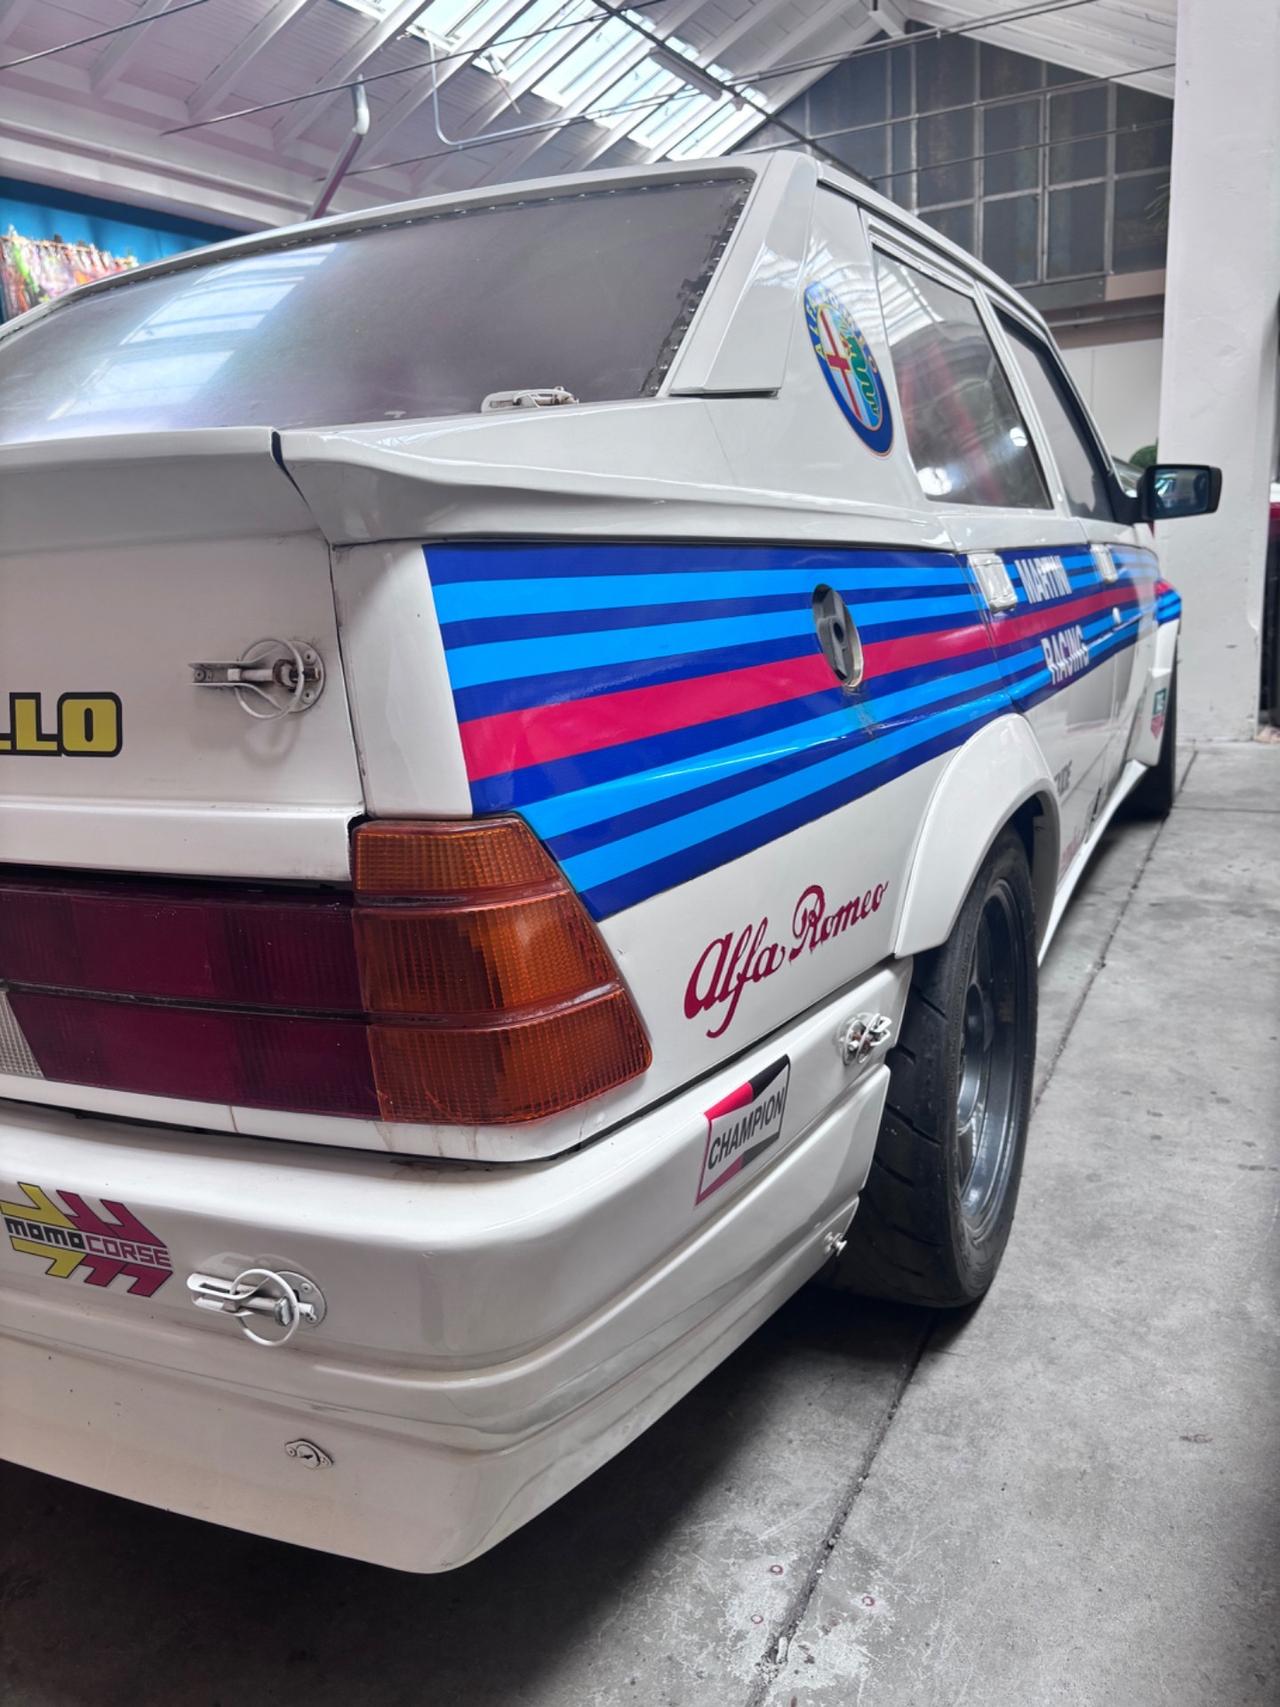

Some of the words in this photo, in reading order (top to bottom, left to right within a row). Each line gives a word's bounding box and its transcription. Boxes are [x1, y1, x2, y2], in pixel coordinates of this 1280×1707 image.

[1014, 555, 1072, 604] MARTINI
[1041, 625, 1089, 685] RACING
[684, 917, 785, 1038] Alfa
[789, 881, 889, 963] Romeo
[708, 1087, 785, 1170] CHAMPION
